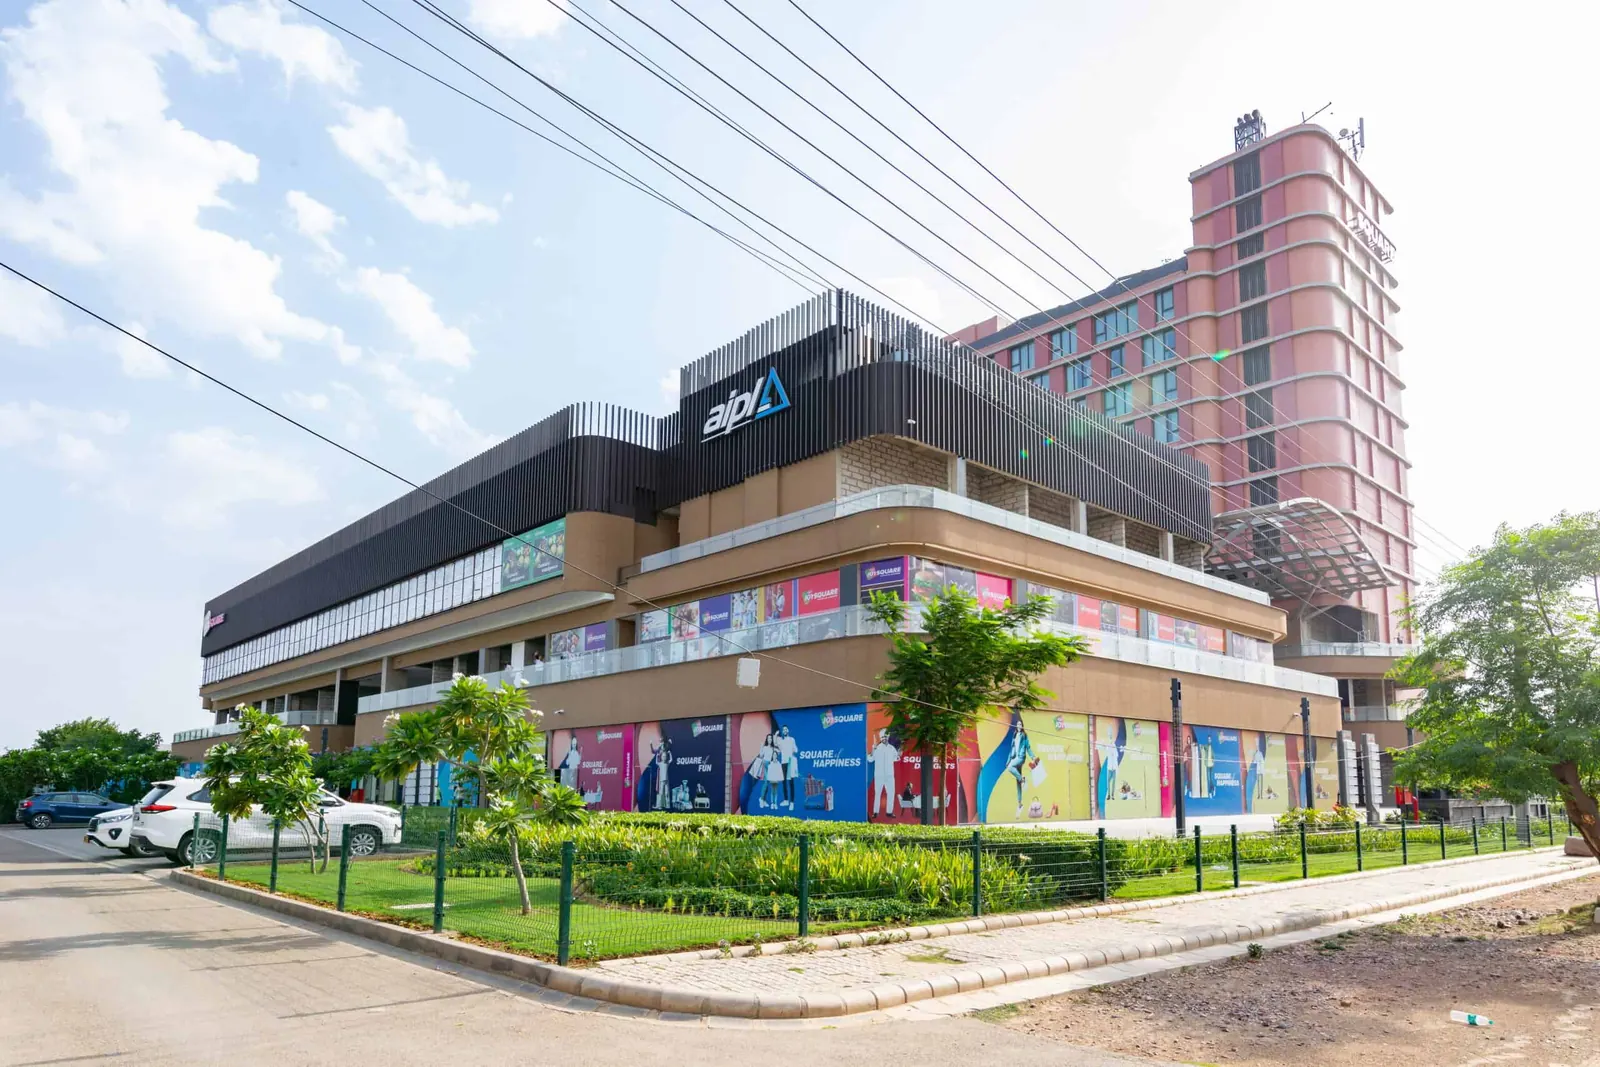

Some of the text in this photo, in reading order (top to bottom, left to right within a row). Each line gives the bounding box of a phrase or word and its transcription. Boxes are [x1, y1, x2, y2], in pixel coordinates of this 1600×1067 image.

[703, 377, 765, 435] aipl
[799, 749, 834, 760] SQUARE
[676, 756, 703, 765] SQUARE
[812, 757, 862, 768] HAPPINESS
[902, 755, 939, 763] SQUE
[582, 761, 603, 769] SQUARE
[697, 764, 713, 772] FUN
[592, 767, 618, 775] DELIGHTS
